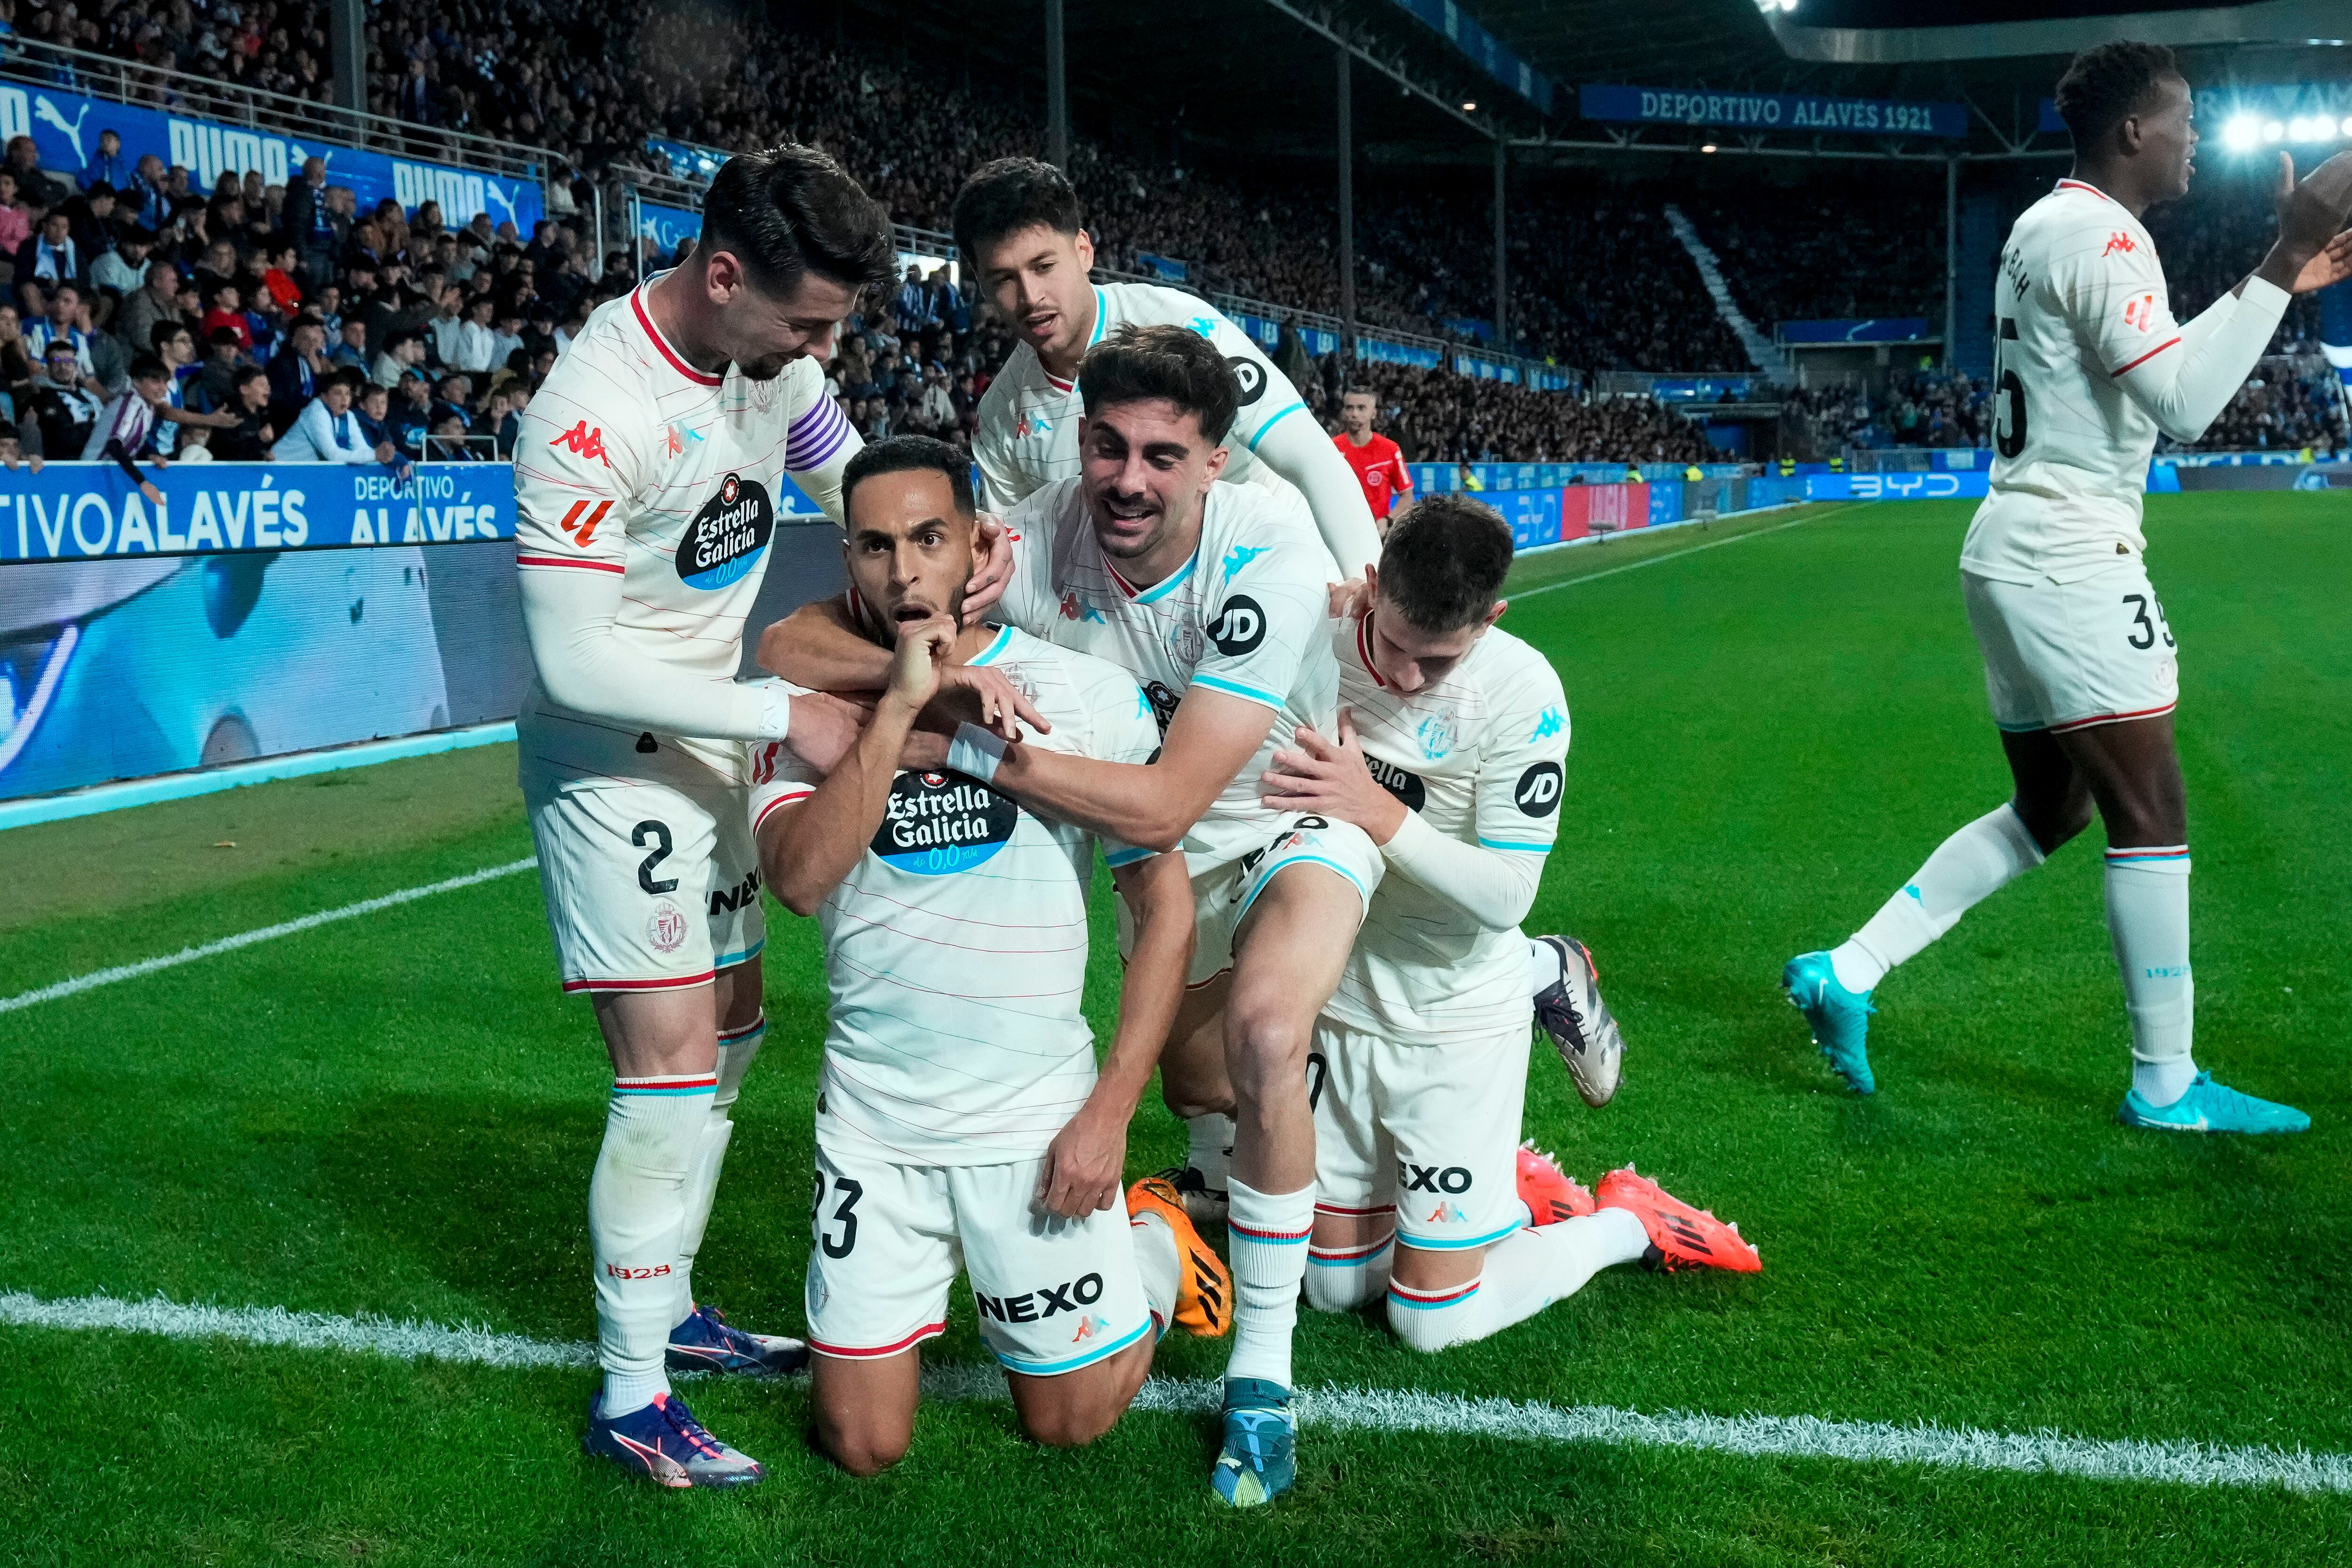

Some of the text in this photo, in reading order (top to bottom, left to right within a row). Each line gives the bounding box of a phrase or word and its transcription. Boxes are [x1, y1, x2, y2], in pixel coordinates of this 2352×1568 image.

[1641, 92, 1932, 130] DEPORTIVO ALAVÉS 1921
[168, 119, 288, 191] PUMA
[392, 161, 485, 228] PUMA
[1233, 362, 1259, 393] D
[694, 498, 759, 544] Estrella
[696, 525, 755, 568] Galicia
[1216, 608, 1259, 642] JD
[886, 785, 991, 820] Estrella
[1519, 772, 1558, 804] JD
[893, 812, 990, 847] Galicia
[632, 820, 679, 895] 2
[1398, 1160, 1472, 1194] EXO
[608, 1264, 670, 1280] 1928
[975, 1272, 1103, 1324] NEXO
